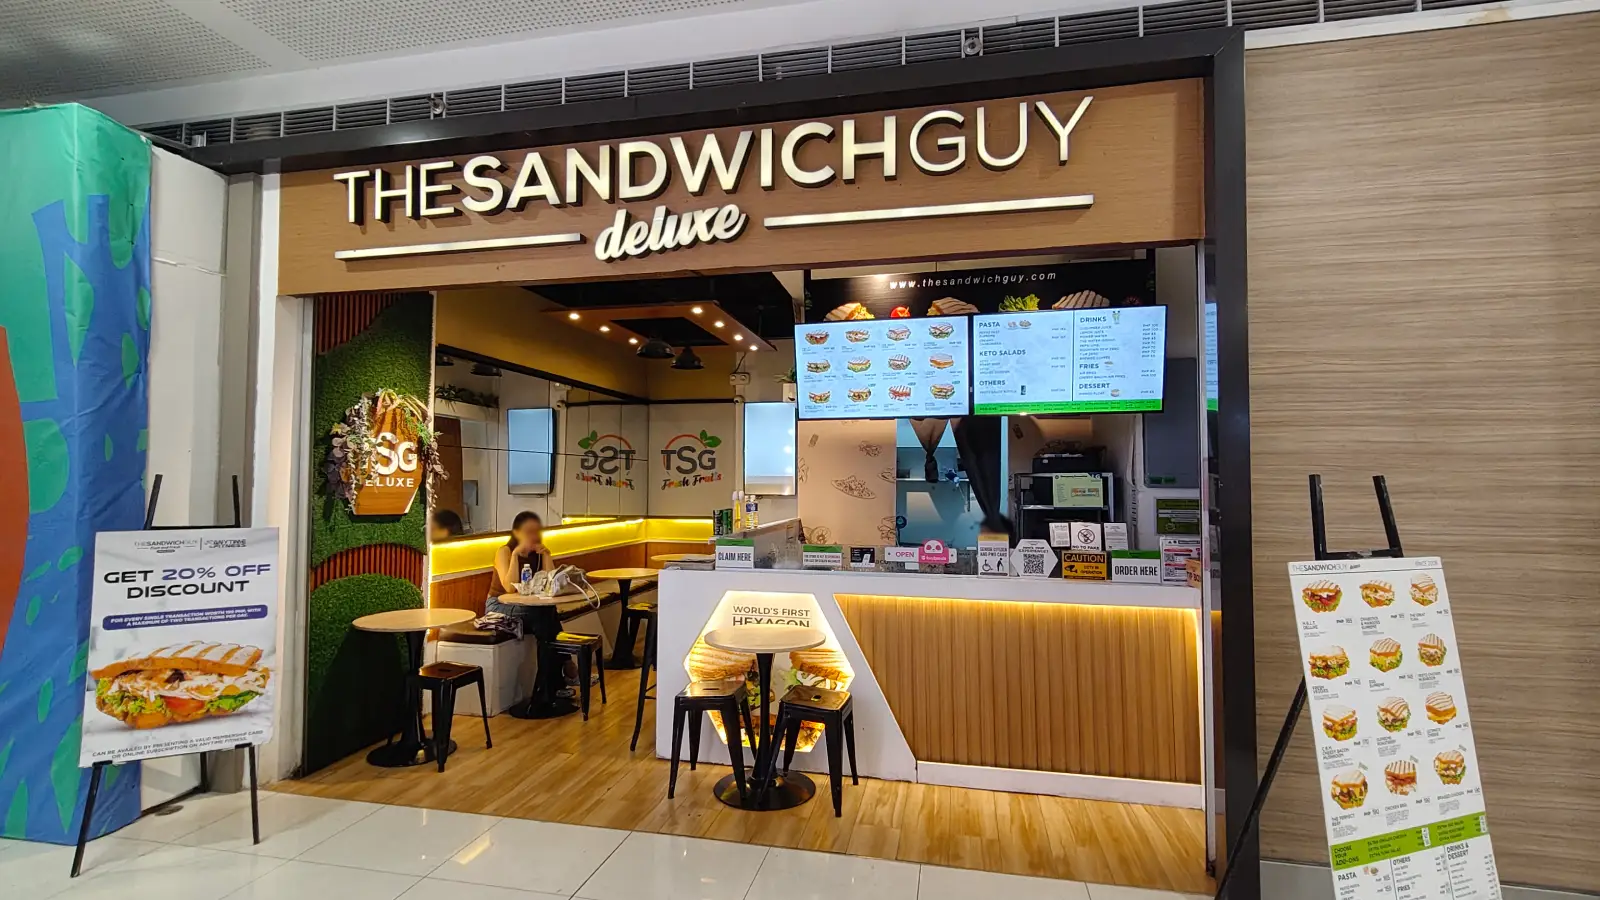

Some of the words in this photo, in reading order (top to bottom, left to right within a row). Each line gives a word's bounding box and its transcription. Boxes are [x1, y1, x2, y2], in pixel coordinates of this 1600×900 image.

[334, 96, 1093, 223] THESANDWICHGUY
[594, 203, 747, 262] deluxe
[889, 271, 1057, 290] www.thesandwichguy.com
[979, 321, 1000, 329] PASTA
[660, 445, 716, 475] TSG
[358, 477, 414, 488] ELUXE
[718, 552, 736, 561] CLAIM
[737, 552, 752, 562] HERE
[1064, 554, 1104, 562] CAUTION
[104, 570, 154, 584] GET
[161, 566, 216, 581] 20%
[224, 564, 271, 577] OFF
[1114, 565, 1138, 576] ORDER
[1140, 566, 1158, 577] HERE
[126, 580, 250, 600] DISCOUNT
[165, 611, 205, 619] TRANSACTION
[733, 606, 779, 615] WORLD'S
[781, 608, 810, 617] FIRST
[146, 744, 188, 755] SUBSCRIPTION
[152, 739, 188, 749] PRESENTING
[1334, 845, 1352, 854] CHOOSE
[1446, 844, 1464, 854] DRINKS
[1447, 849, 1469, 861] DESSERT
[1335, 856, 1360, 867] ADD-ONS
[1392, 856, 1411, 866] OTHERS
[1337, 871, 1358, 882] PASTA
[1397, 884, 1410, 894] FRIES
